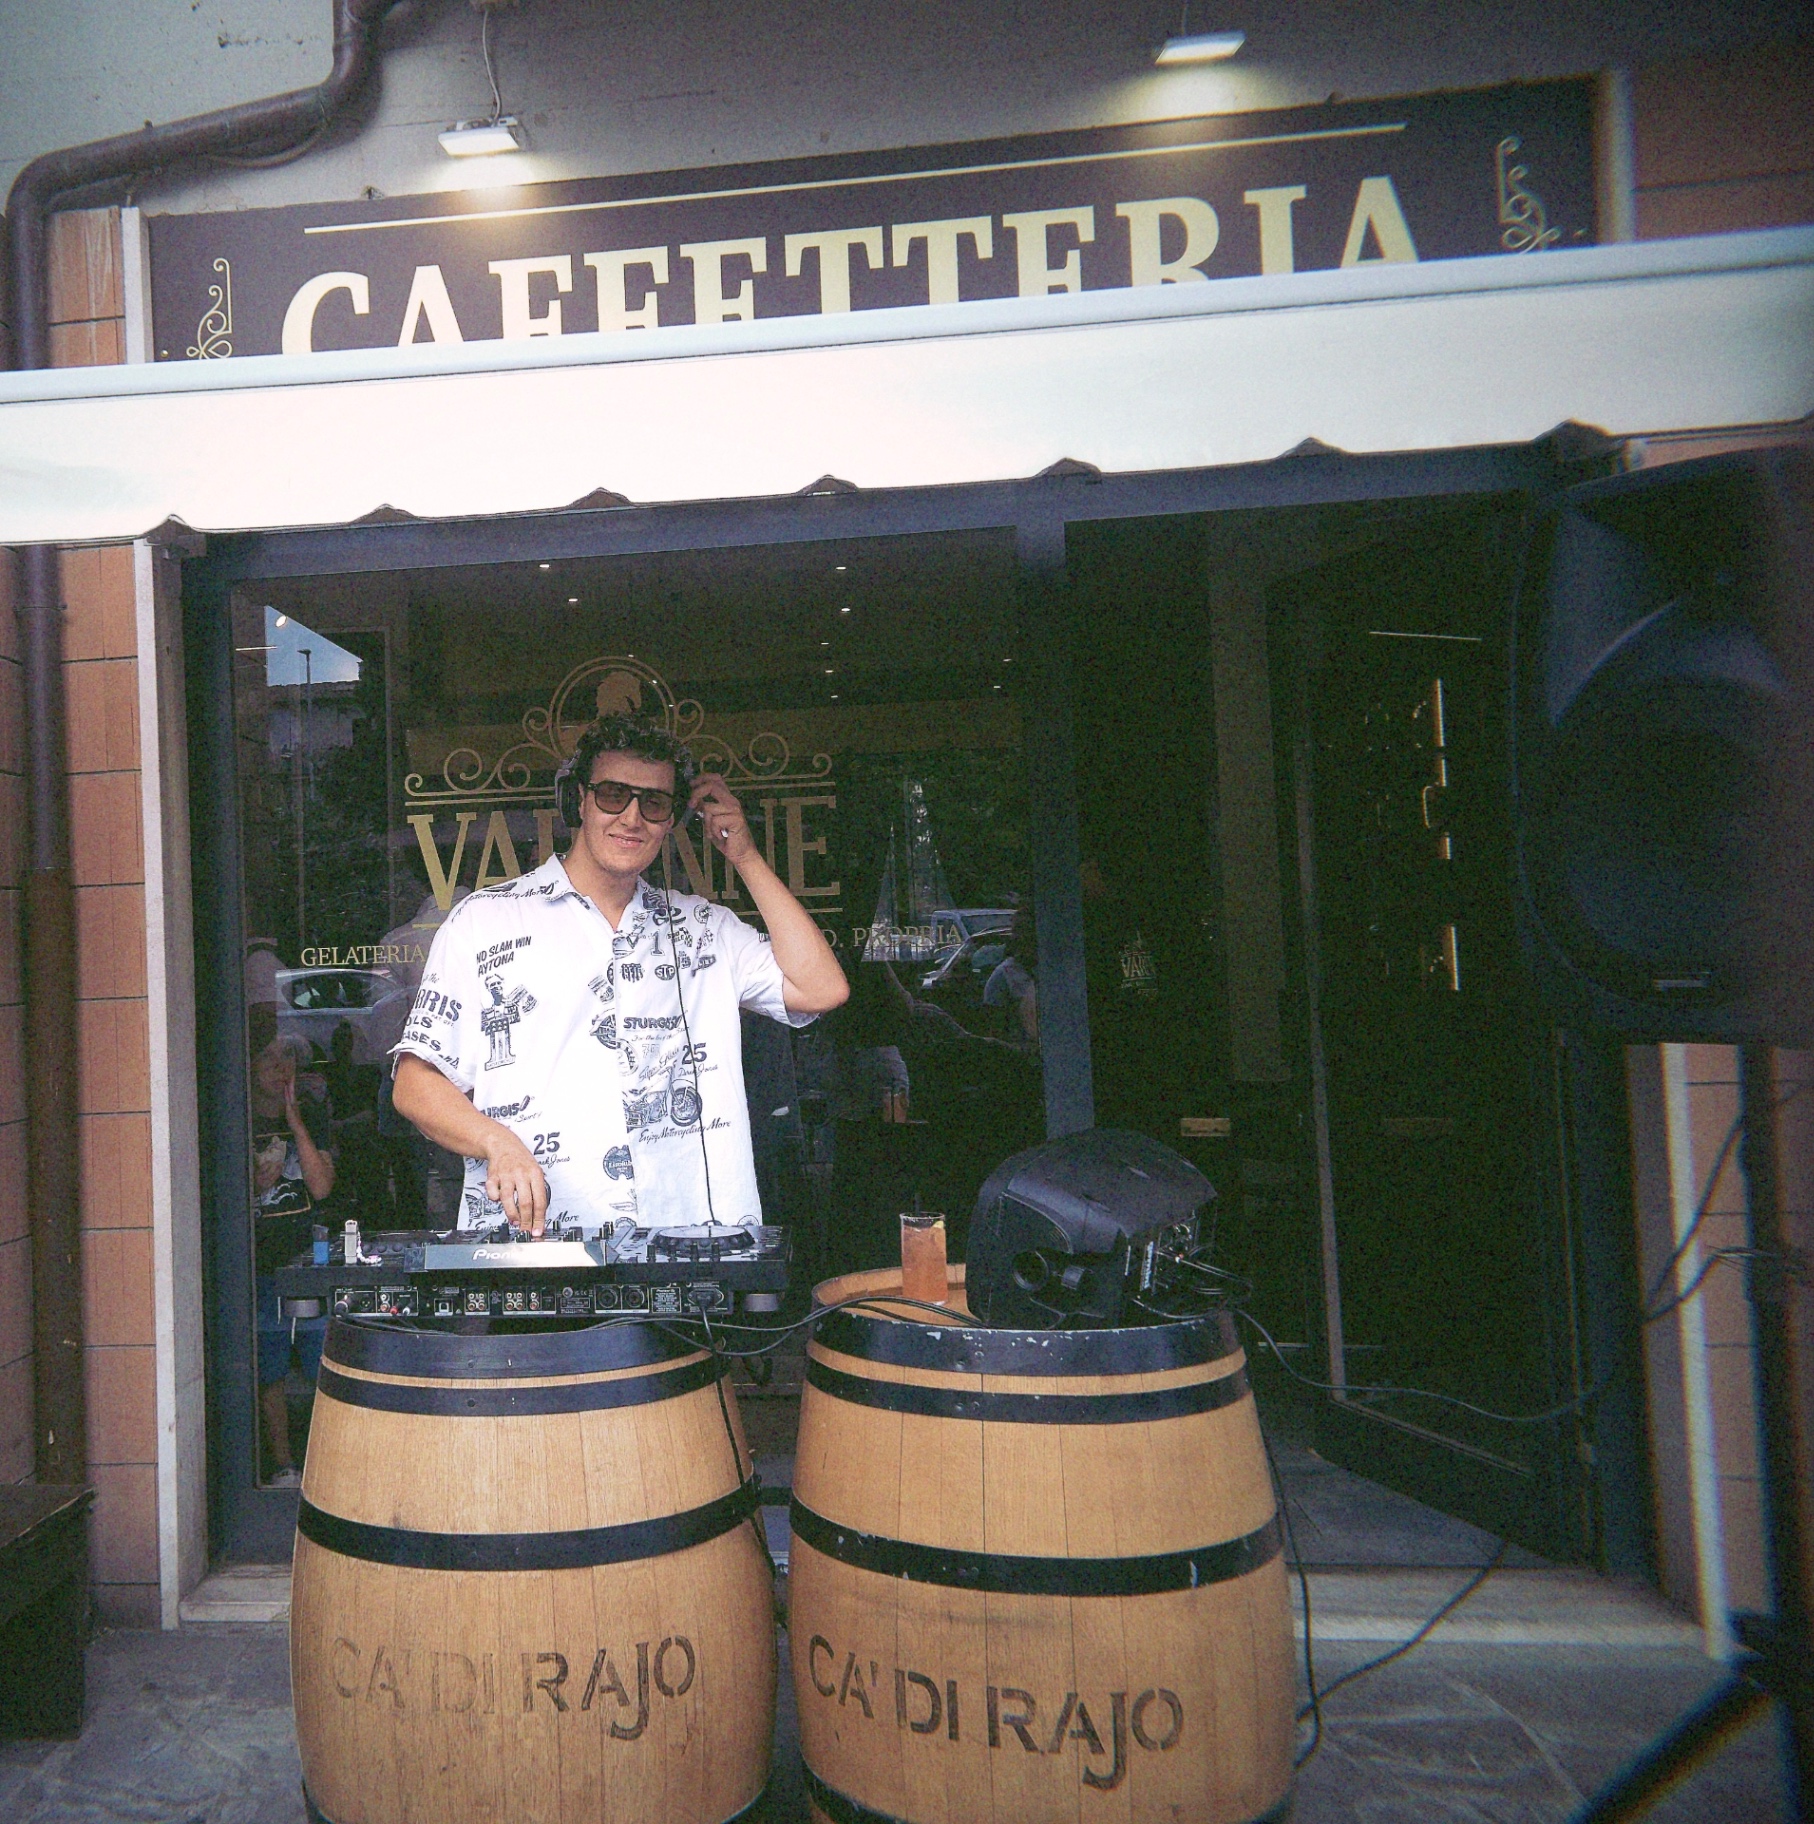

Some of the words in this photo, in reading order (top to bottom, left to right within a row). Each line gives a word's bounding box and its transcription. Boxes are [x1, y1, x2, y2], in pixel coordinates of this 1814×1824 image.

[489, 940, 513, 957] SLAM
[515, 936, 532, 949] WIN
[852, 925, 963, 948] PROPRIA
[301, 944, 427, 967] GELATERIA
[477, 951, 515, 977] AYTONA
[656, 965, 675, 979] STP
[681, 1042, 707, 1065] 25
[706, 1117, 732, 1131] More
[533, 1131, 560, 1156] 25
[432, 1651, 494, 1713] DI
[521, 1635, 696, 1741] RAJO
[895, 1669, 960, 1741] DI
[986, 1686, 1184, 1790] RAJO
